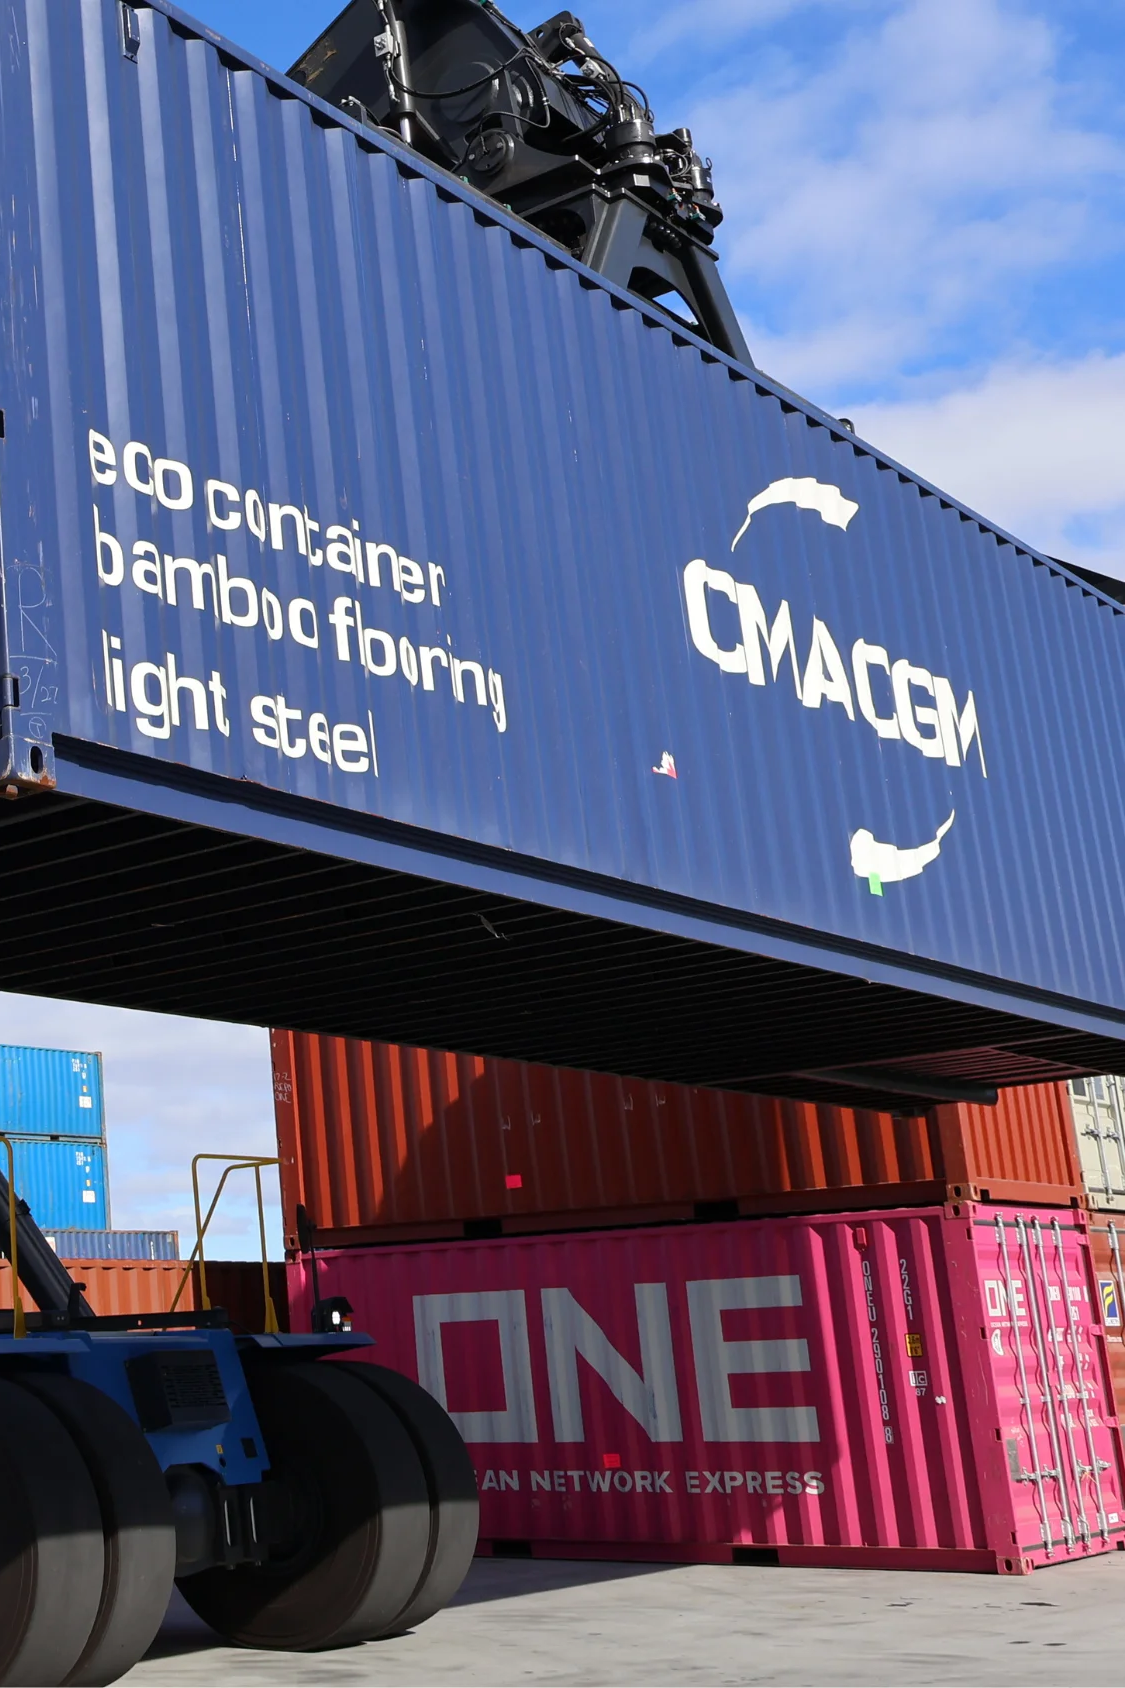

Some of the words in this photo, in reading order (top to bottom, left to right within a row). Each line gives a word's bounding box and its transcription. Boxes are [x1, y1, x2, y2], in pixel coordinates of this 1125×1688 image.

[88, 428, 193, 511] eco
[206, 478, 445, 608] container
[92, 503, 319, 650] bamboo
[328, 596, 507, 734] flooring
[101, 628, 230, 741] light
[250, 692, 379, 779] steel
[413, 1275, 820, 1443] ONE
[862, 1260, 876, 1322] ONEU
[871, 1328, 890, 1420] 290108
[885, 1427, 893, 1443] 8
[899, 1259, 913, 1320] 22G1
[984, 1280, 1026, 1317] ONE
[915, 1387, 926, 1396] 87
[474, 1469, 520, 1491] AN
[530, 1469, 672, 1494] NETWORK
[686, 1471, 825, 1495] EXPRESS
